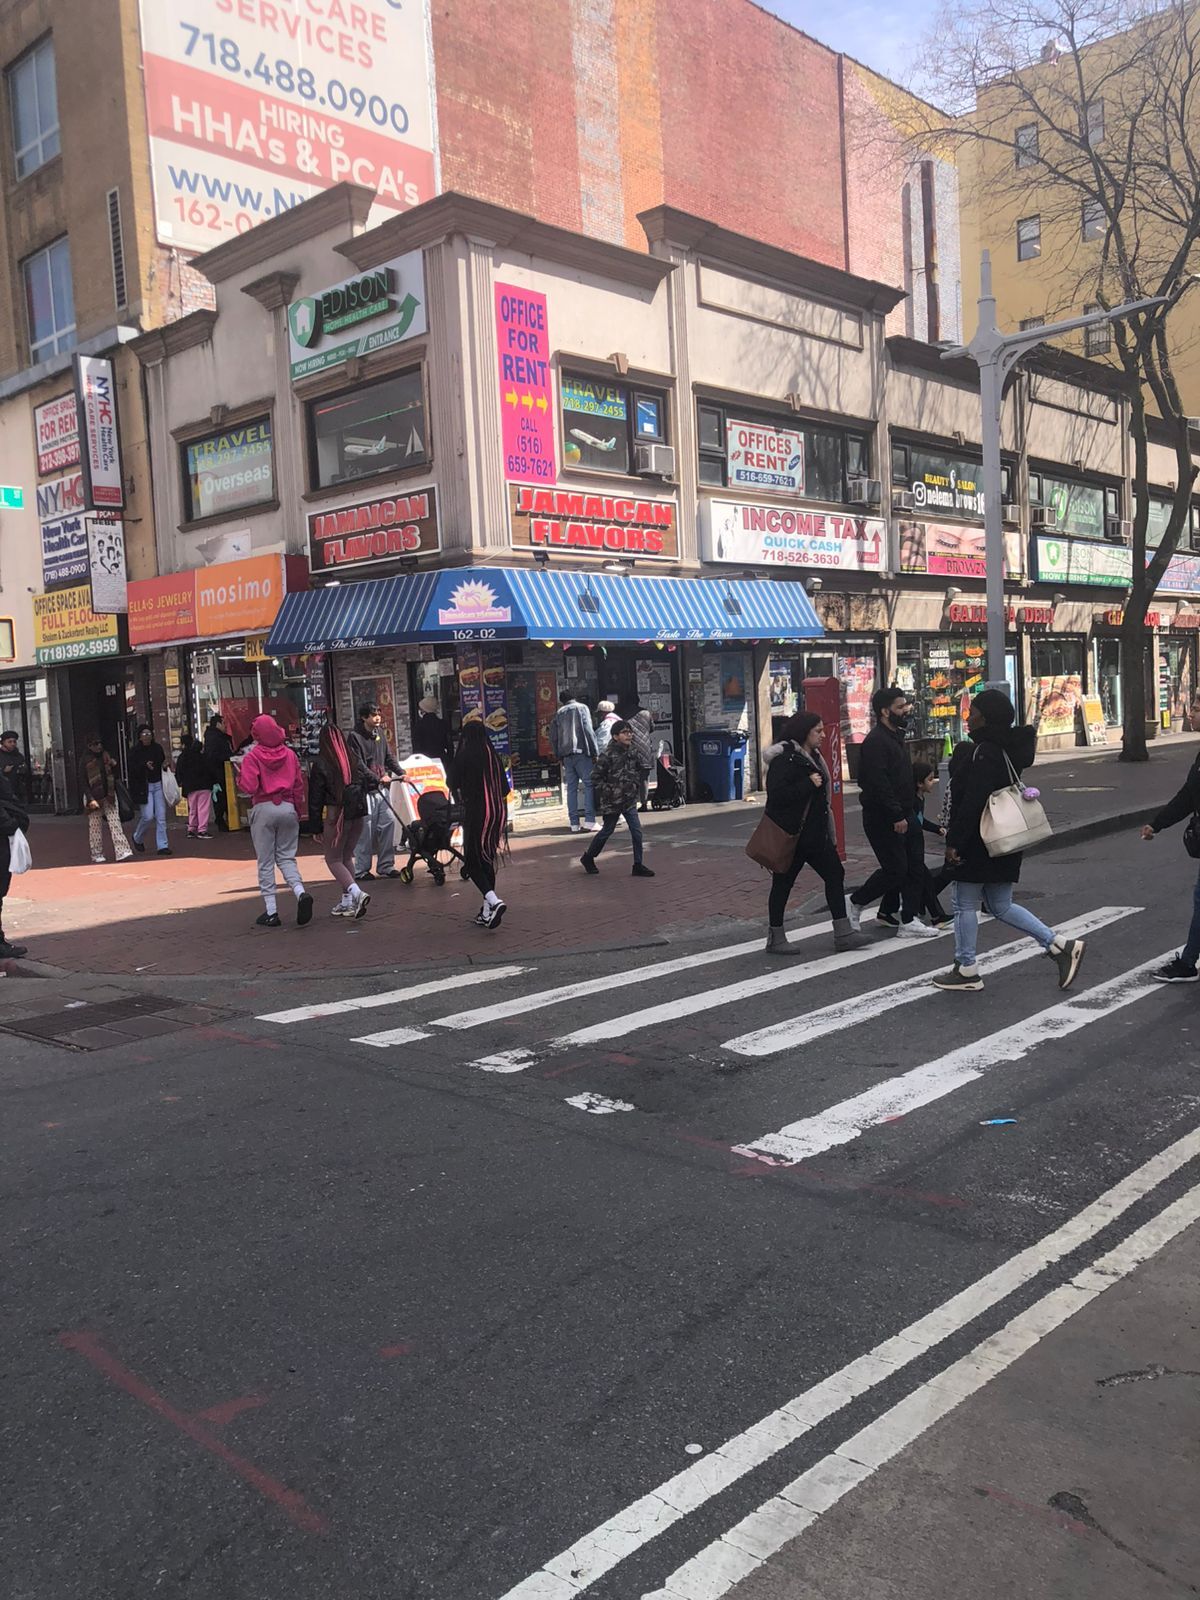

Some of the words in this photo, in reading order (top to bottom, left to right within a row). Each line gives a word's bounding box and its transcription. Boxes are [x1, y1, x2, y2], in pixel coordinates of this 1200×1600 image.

[179, 21, 409, 134] 718.488.0900
[259, 100, 345, 148] HIRING
[171, 95, 287, 165] HHA's
[296, 139, 322, 177] &
[329, 148, 420, 206] PCA's
[173, 196, 258, 235] 162-0
[321, 267, 390, 318] EDISON
[325, 317, 344, 332] HOME
[344, 309, 369, 324] HEALTH
[369, 300, 388, 314] CARE
[501, 295, 544, 330] OFFICE
[368, 327, 400, 348] ENTRANCE
[508, 328, 538, 353] FOR
[294, 363, 307, 374] NOW
[307, 355, 325, 368] HIRING
[503, 354, 547, 387] RENT
[96, 376, 113, 425] NYHC
[562, 380, 625, 404] TRAVEL
[87, 402, 96, 425] CARE
[520, 417, 538, 433] CALL
[40, 420, 56, 443] FOR
[57, 411, 76, 435] REN
[90, 427, 99, 470] SERVICES
[192, 424, 272, 459] TRAVEL
[516, 435, 543, 456] (516)
[738, 430, 792, 456] OFFICES
[507, 455, 553, 477] 659-7621
[744, 451, 788, 472] RENT
[203, 464, 271, 495] Overseas
[740, 470, 793, 486] 516-659-7621
[924, 473, 950, 487] BEAUTY
[957, 479, 977, 491] SALON
[314, 493, 430, 540] JAMAICAN
[517, 487, 672, 528] JAMAICAN
[530, 517, 665, 553] FLAVORS
[742, 507, 827, 538] INCOME
[830, 517, 868, 542] TAX
[70, 532, 88, 547] Car
[323, 524, 421, 566] FLAVORS
[764, 535, 806, 550] QUICK
[809, 540, 842, 553] CASH
[761, 549, 840, 566] 718-526-3630
[34, 596, 57, 617] OFFICE
[56, 591, 77, 612] SPACE
[78, 588, 92, 608] AVA
[156, 590, 193, 610] JEWELRY
[200, 576, 272, 608] mosimo
[41, 612, 66, 631] FULL
[1025, 606, 1055, 624] DELI
[99, 622, 109, 634] LLC
[452, 628, 496, 640] 162-02
[196, 666, 211, 676] RENT
[197, 656, 209, 665] FOR
